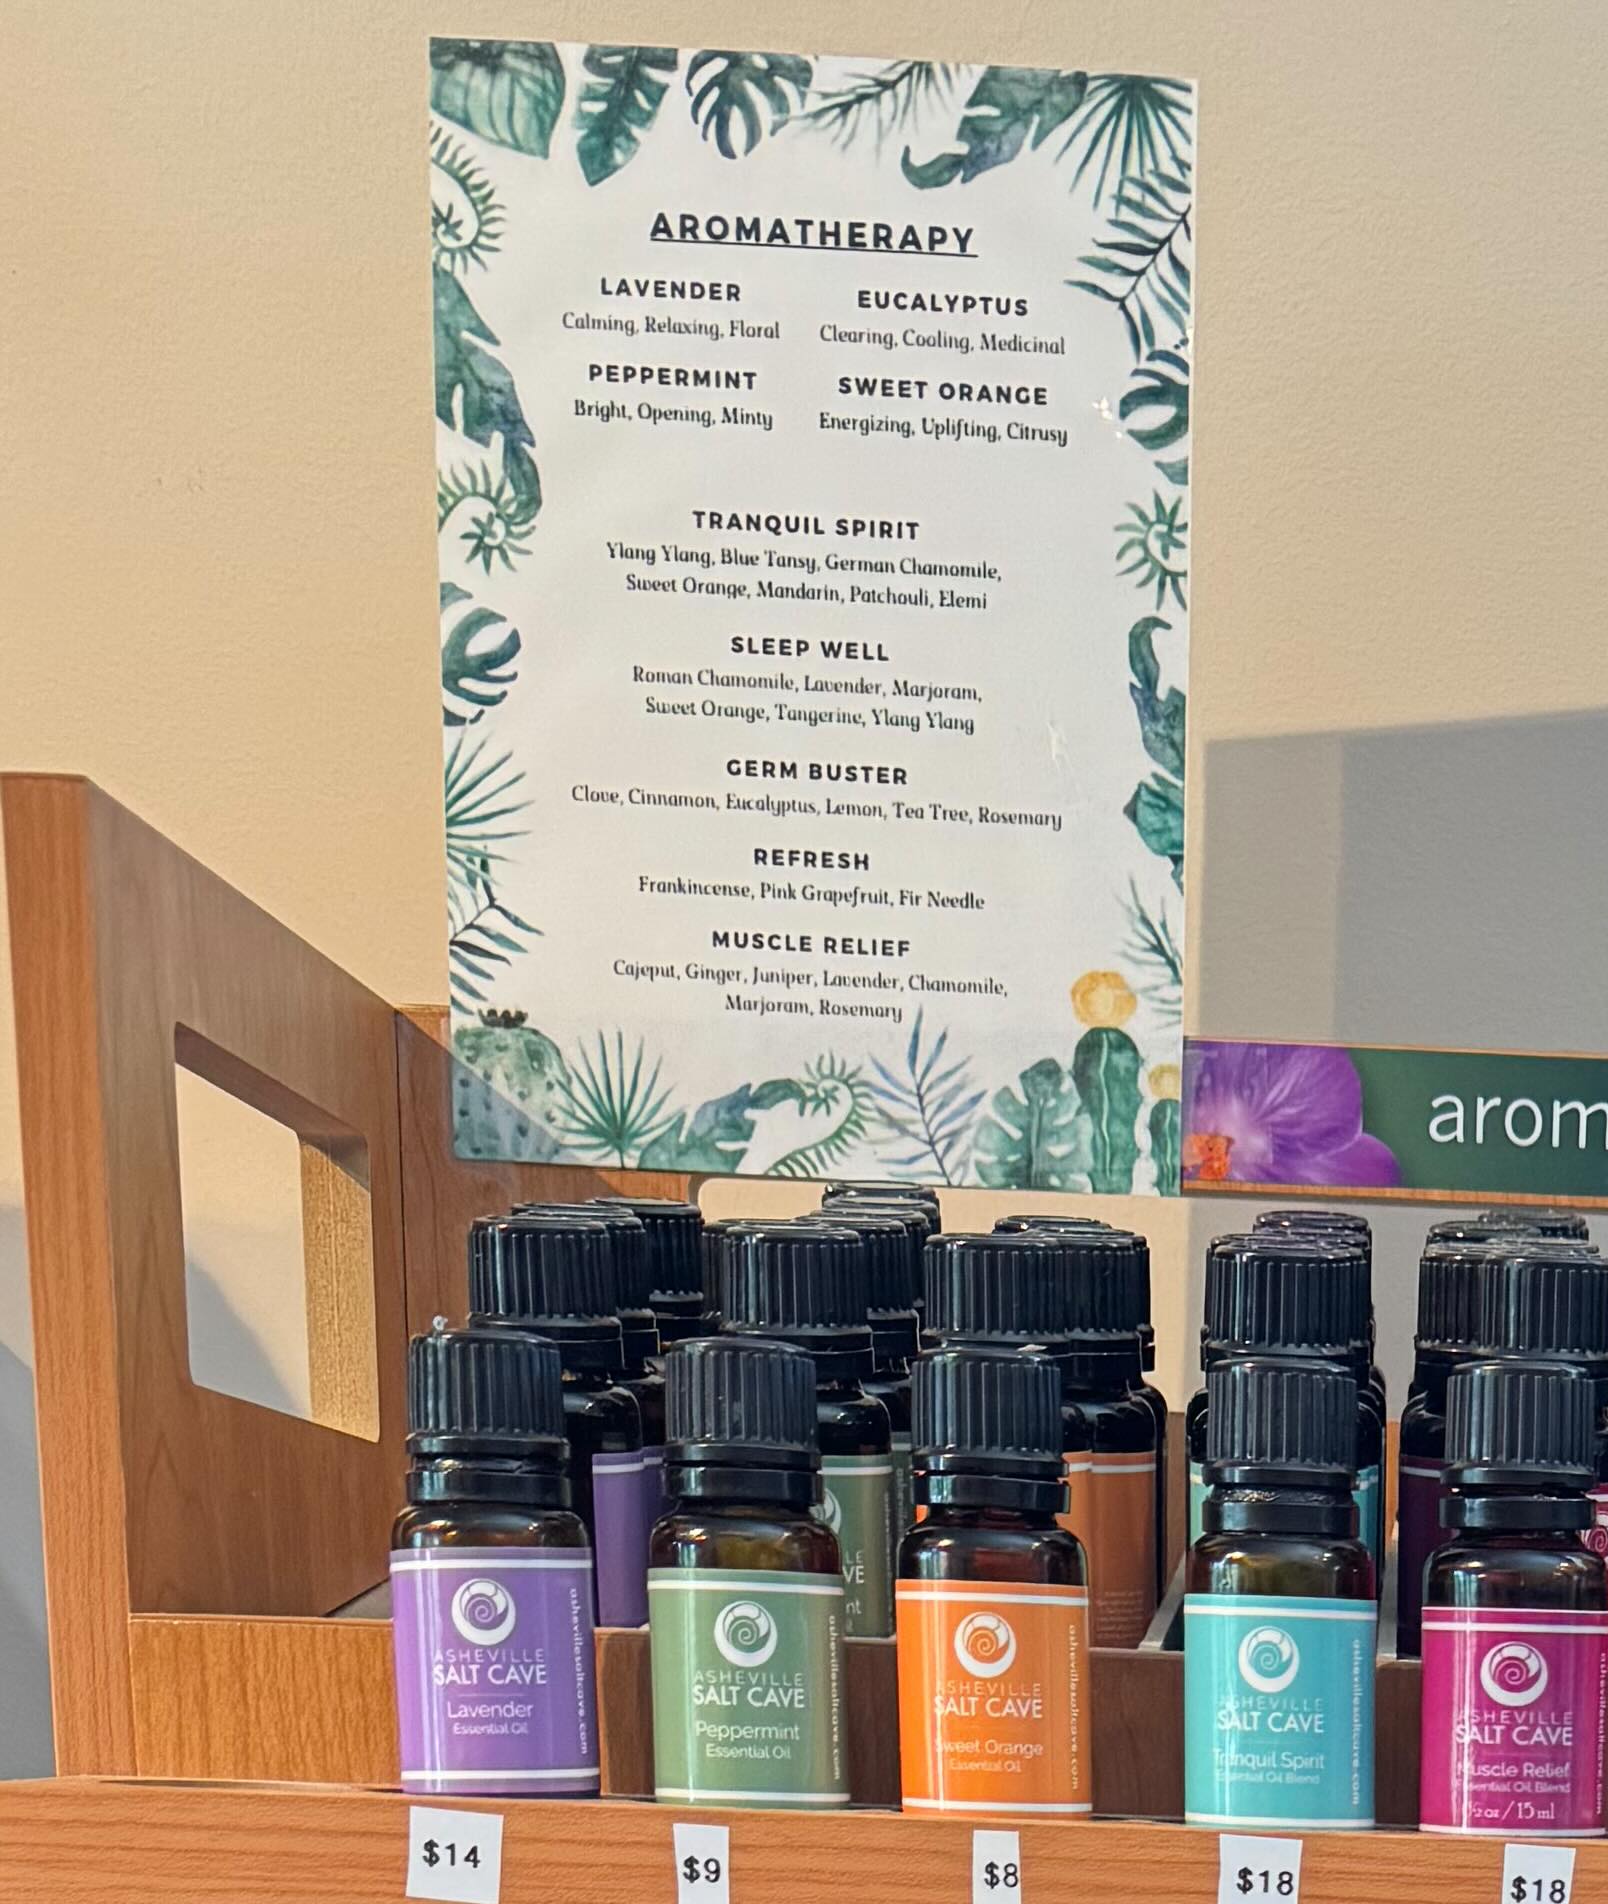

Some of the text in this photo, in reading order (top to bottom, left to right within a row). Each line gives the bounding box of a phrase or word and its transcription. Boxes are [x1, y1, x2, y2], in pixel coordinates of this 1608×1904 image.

[651, 213, 975, 254] AROMATHERAPY
[601, 278, 740, 301] LAVENDER
[858, 290, 1027, 316] EUCALYPTUS
[563, 312, 779, 341] Calming, Relaxing, Floral
[820, 325, 1064, 354] Clearing, Cooling, Medicinal
[590, 364, 756, 390] PEPPERMINT
[839, 377, 1047, 405] SWEET ORANGE
[575, 400, 772, 431] Bright, Opening, Minty
[820, 412, 1067, 447] Energizing, Uplifting, Citrusy
[693, 511, 919, 540] TRANQUIL SPIRIT
[732, 637, 888, 661] SLEEP WELL
[727, 760, 906, 784] GERM BUSTER
[572, 785, 1061, 831] Clove, Cinnamon, Eucalyptus, Lemon, Tea Tree, Rosemary
[754, 848, 868, 870] REFRESH
[640, 876, 984, 909] Frankincense, Pink Grapefruit, Fir Needle
[713, 931, 909, 956] MUSCLE RELIEF
[726, 995, 902, 1023] Marjoram, Rosemary
[434, 1664, 547, 1685] SALT CAVE
[694, 1670, 802, 1686] ASHEVILLE
[693, 1685, 805, 1708] SALT CAVE
[934, 1696, 1042, 1718] SALT CAVE
[448, 1701, 532, 1719] Lavender
[695, 1720, 800, 1744] Peppermint
[1455, 1724, 1572, 1746] SALT CAVE
[706, 1744, 791, 1760] Essential Oil
[423, 1839, 480, 1868] $14
[683, 1856, 720, 1883] $9
[984, 1862, 1018, 1889] $8
[1237, 1867, 1293, 1895] $18
[1511, 1876, 1565, 1904] $18
